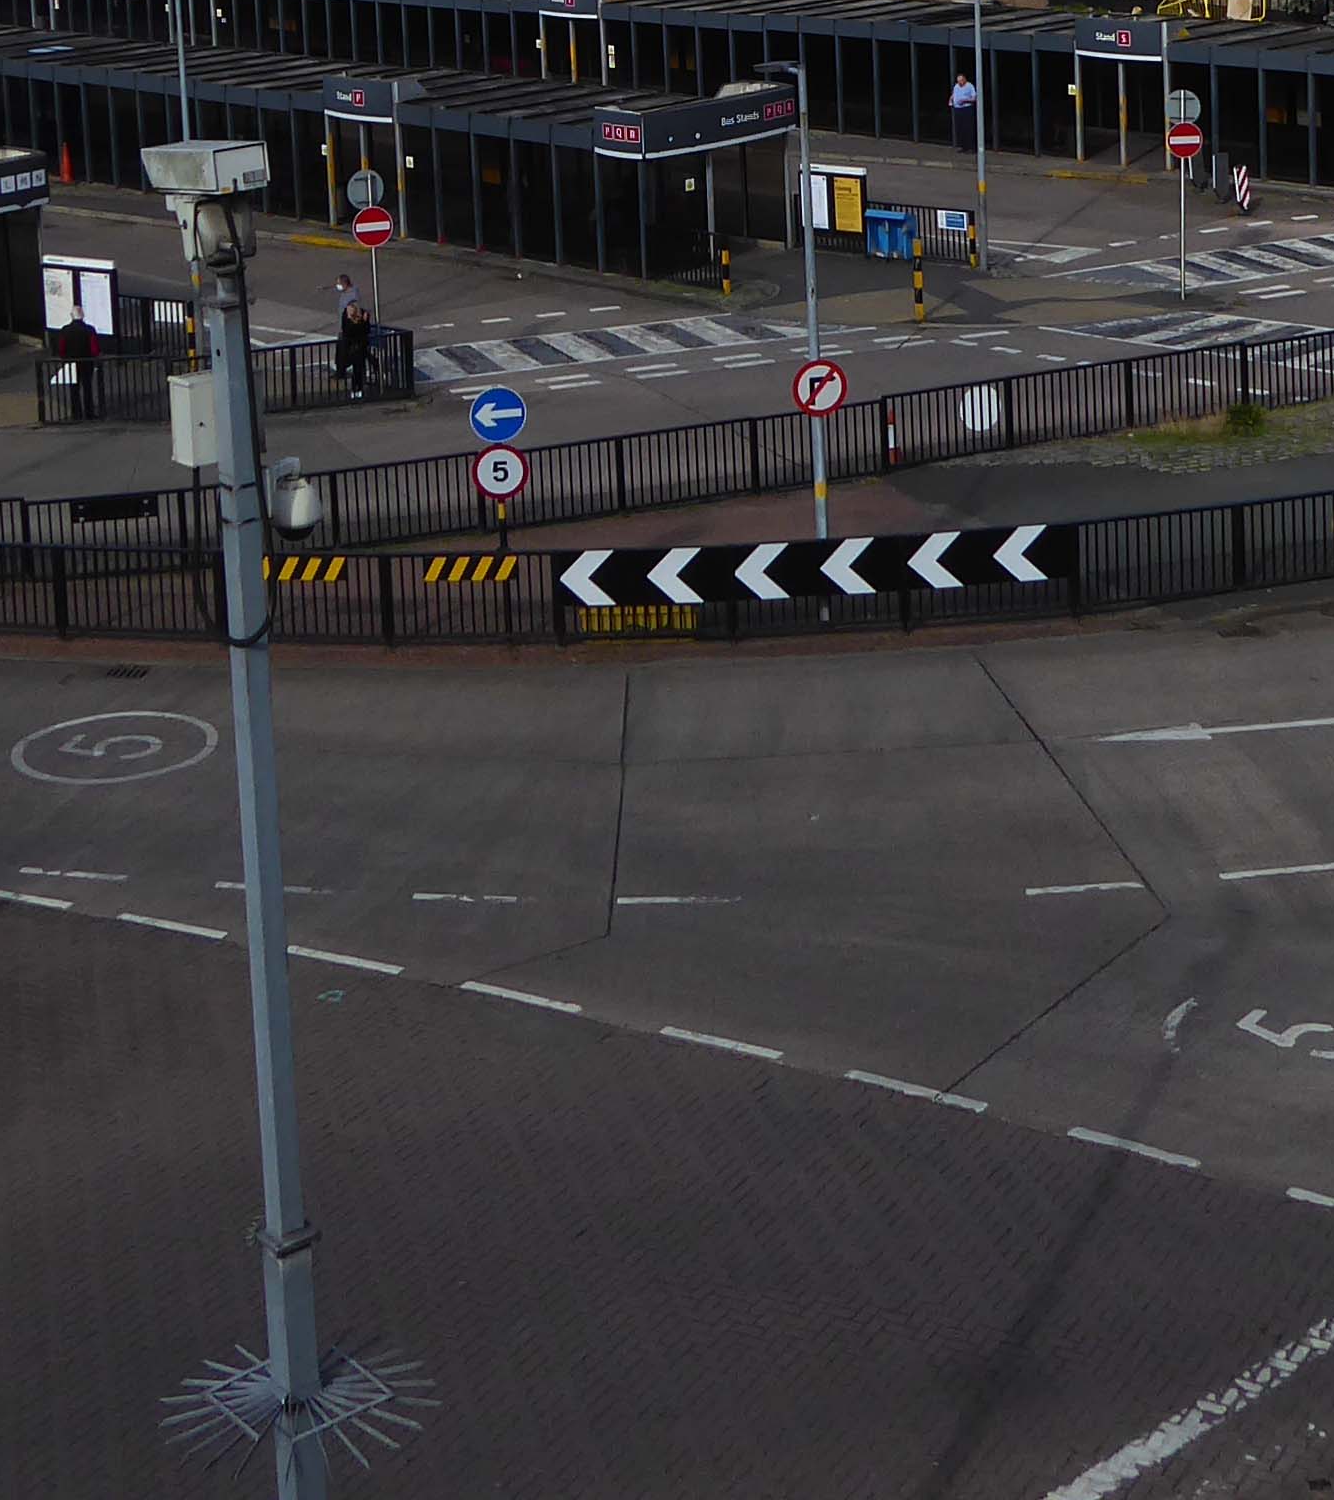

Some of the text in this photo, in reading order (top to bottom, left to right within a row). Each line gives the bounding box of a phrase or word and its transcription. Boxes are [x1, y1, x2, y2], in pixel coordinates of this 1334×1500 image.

[1095, 31, 1116, 42] Stand
[492, 460, 509, 483] 5
[57, 732, 164, 760] 5
